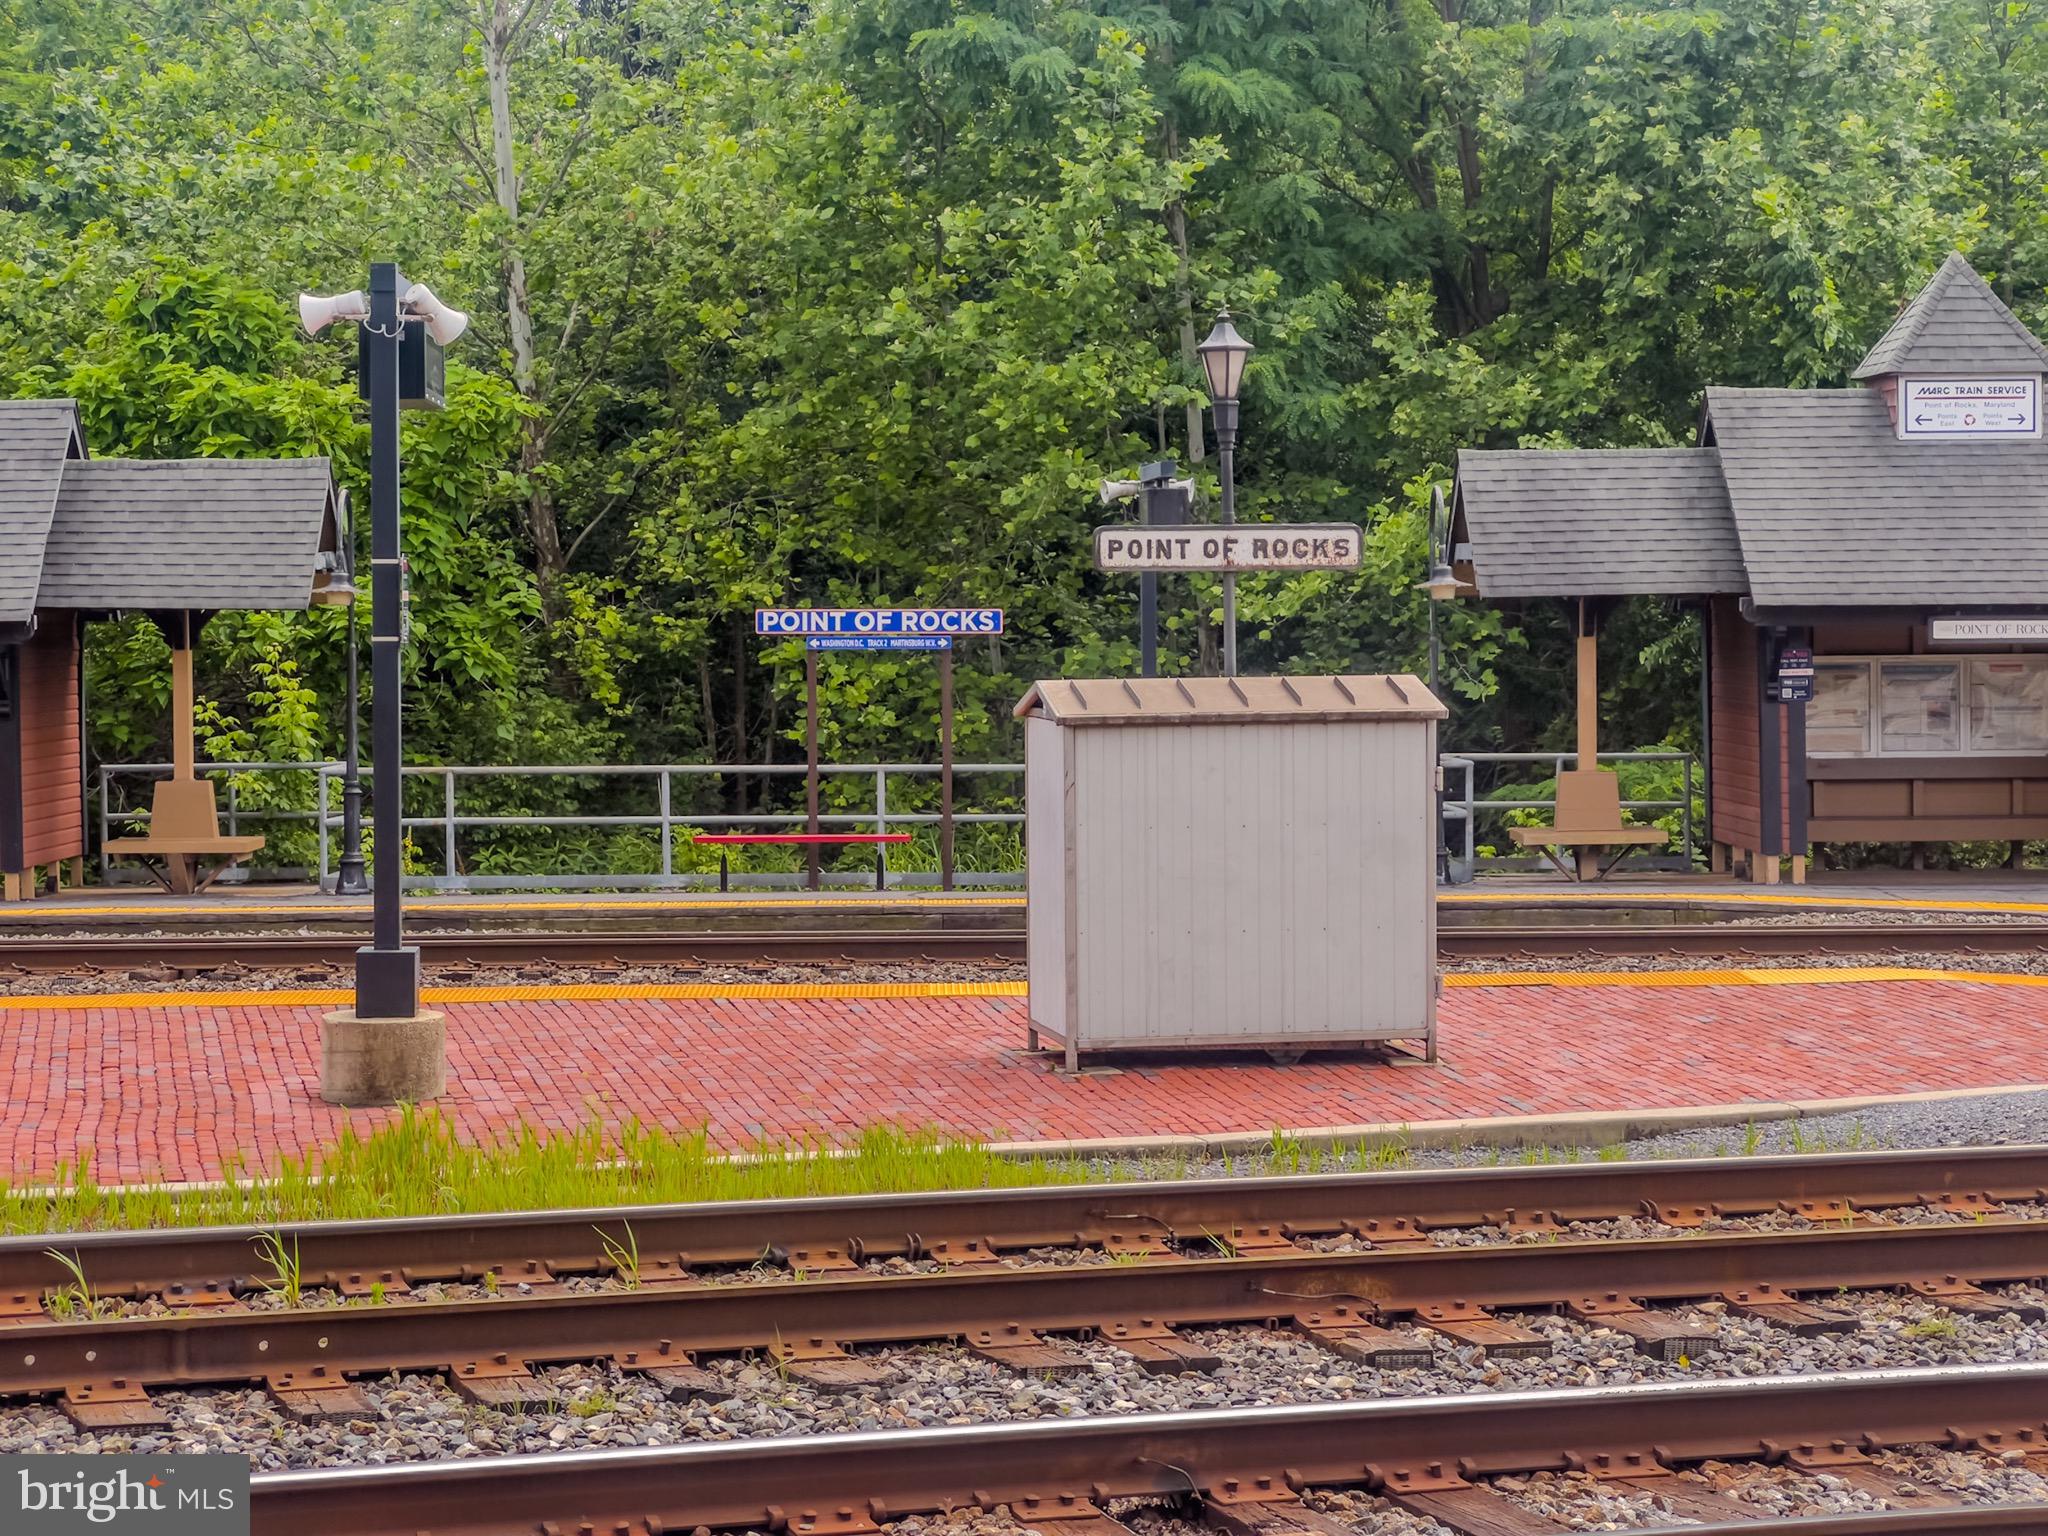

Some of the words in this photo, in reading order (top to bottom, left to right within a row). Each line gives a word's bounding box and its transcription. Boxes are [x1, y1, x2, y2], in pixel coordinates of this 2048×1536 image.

[1918, 386, 1951, 395] MARC
[1955, 386, 1983, 395] TRAIN
[1987, 386, 2027, 395] SERVICE
[1107, 538, 1191, 560] POINT
[1202, 538, 1239, 560] OF
[1252, 537, 1350, 559] ROCKS
[762, 611, 847, 632] POINT
[853, 611, 893, 632] OF
[901, 611, 995, 632] ROCKS
[1954, 624, 1992, 634] POINT
[1995, 624, 2012, 634] OF
[867, 639, 883, 647] TRACK
[883, 639, 888, 647] 2
